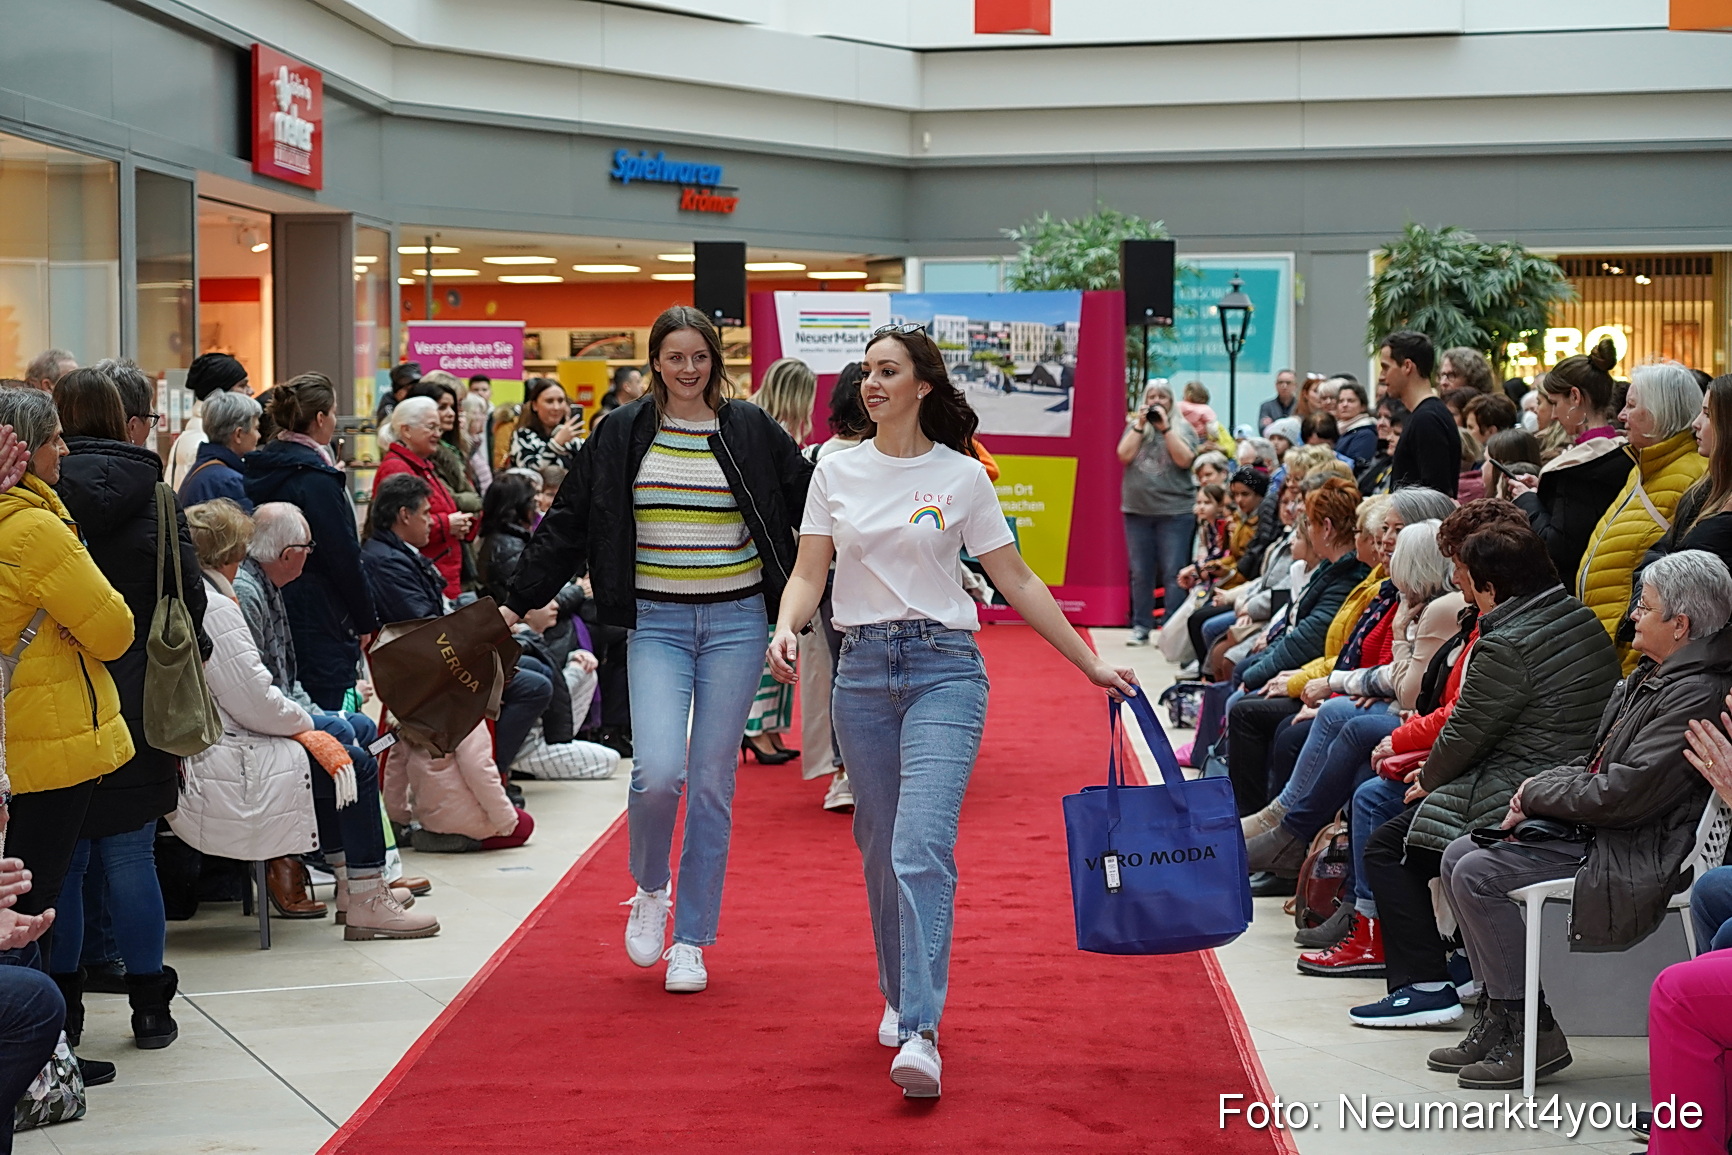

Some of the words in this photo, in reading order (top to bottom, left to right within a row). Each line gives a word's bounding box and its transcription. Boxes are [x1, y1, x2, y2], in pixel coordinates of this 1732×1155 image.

[611, 149, 722, 184] Spielwaren
[681, 188, 739, 213] Krömer
[414, 341, 491, 355] Verschenken
[493, 341, 513, 355] Sie
[439, 356, 513, 370] Gutscheine!
[1014, 483, 1033, 496] Ort
[914, 490, 953, 506] LOVE
[1150, 845, 1217, 865] MODA
